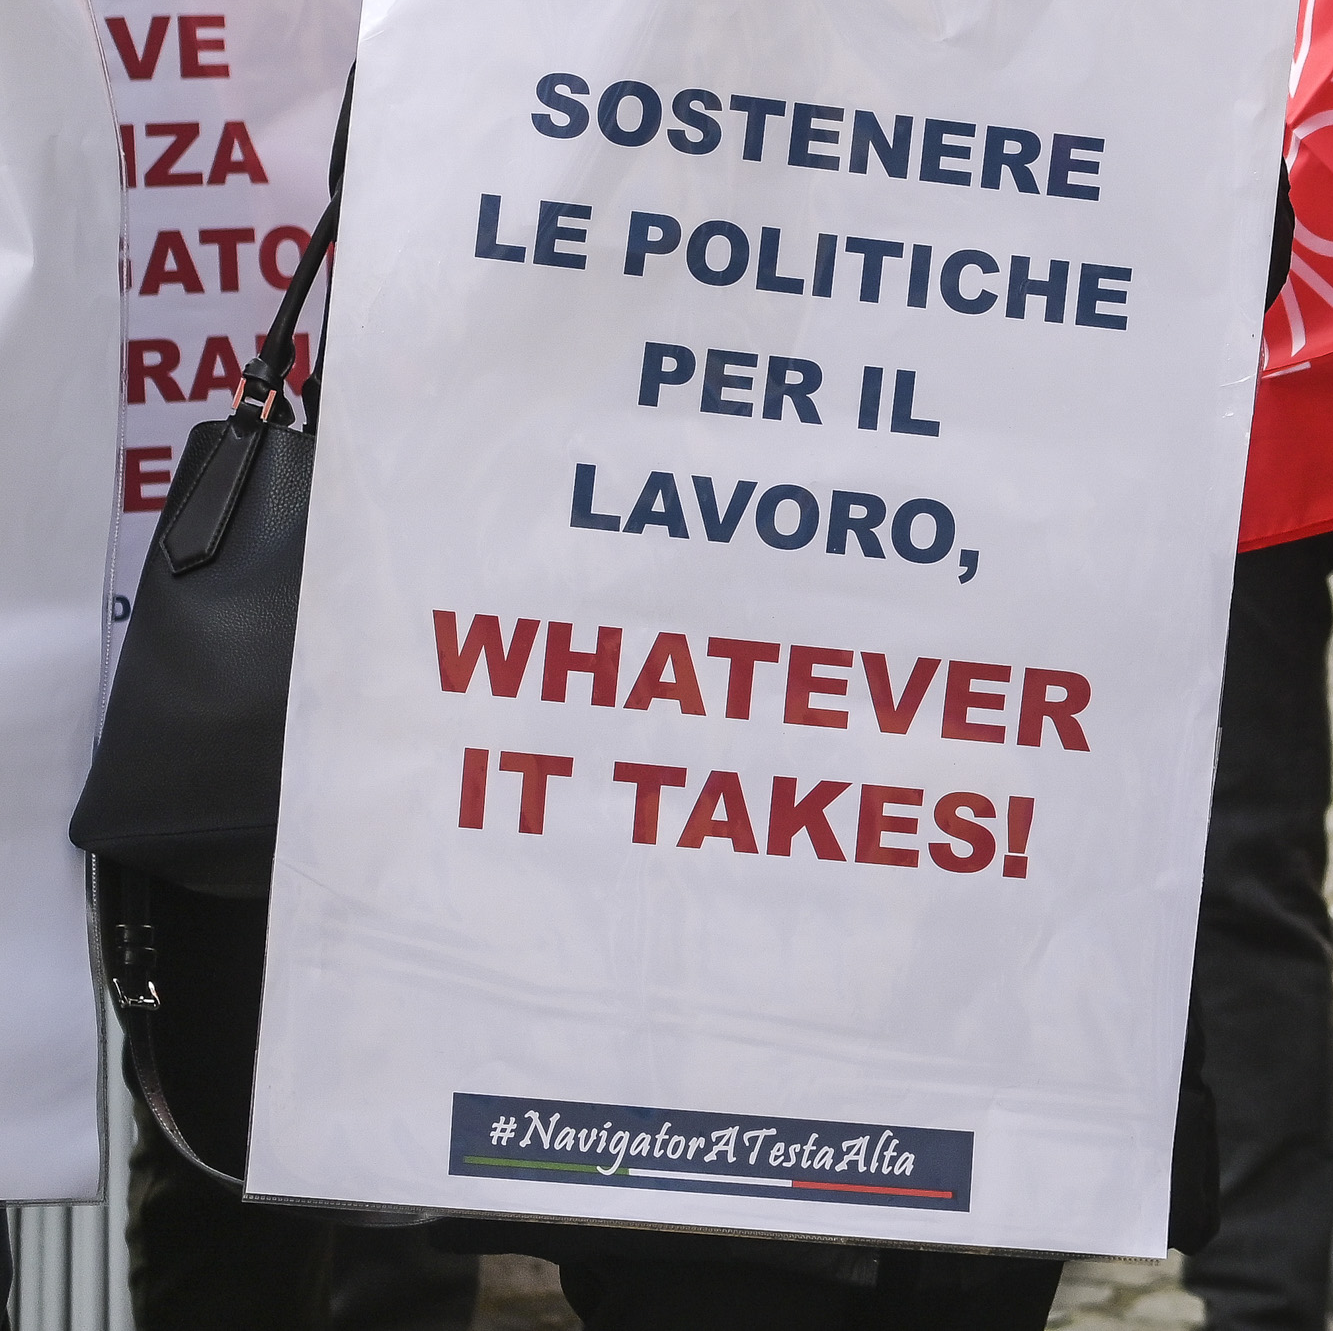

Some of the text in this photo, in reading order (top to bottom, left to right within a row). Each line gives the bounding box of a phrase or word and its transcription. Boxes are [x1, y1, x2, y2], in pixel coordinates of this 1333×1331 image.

[104, 15, 231, 81] VE
[531, 72, 1106, 202] SOSTENERE
[474, 193, 1133, 332] LE POLITICHE
[637, 342, 941, 439] PER IL
[570, 463, 981, 586] LAVORO,
[432, 609, 1093, 752] WHATEVER
[458, 747, 1035, 880] IT TAKES!
[489, 1108, 917, 1179] #NavigatorATestaAlta
